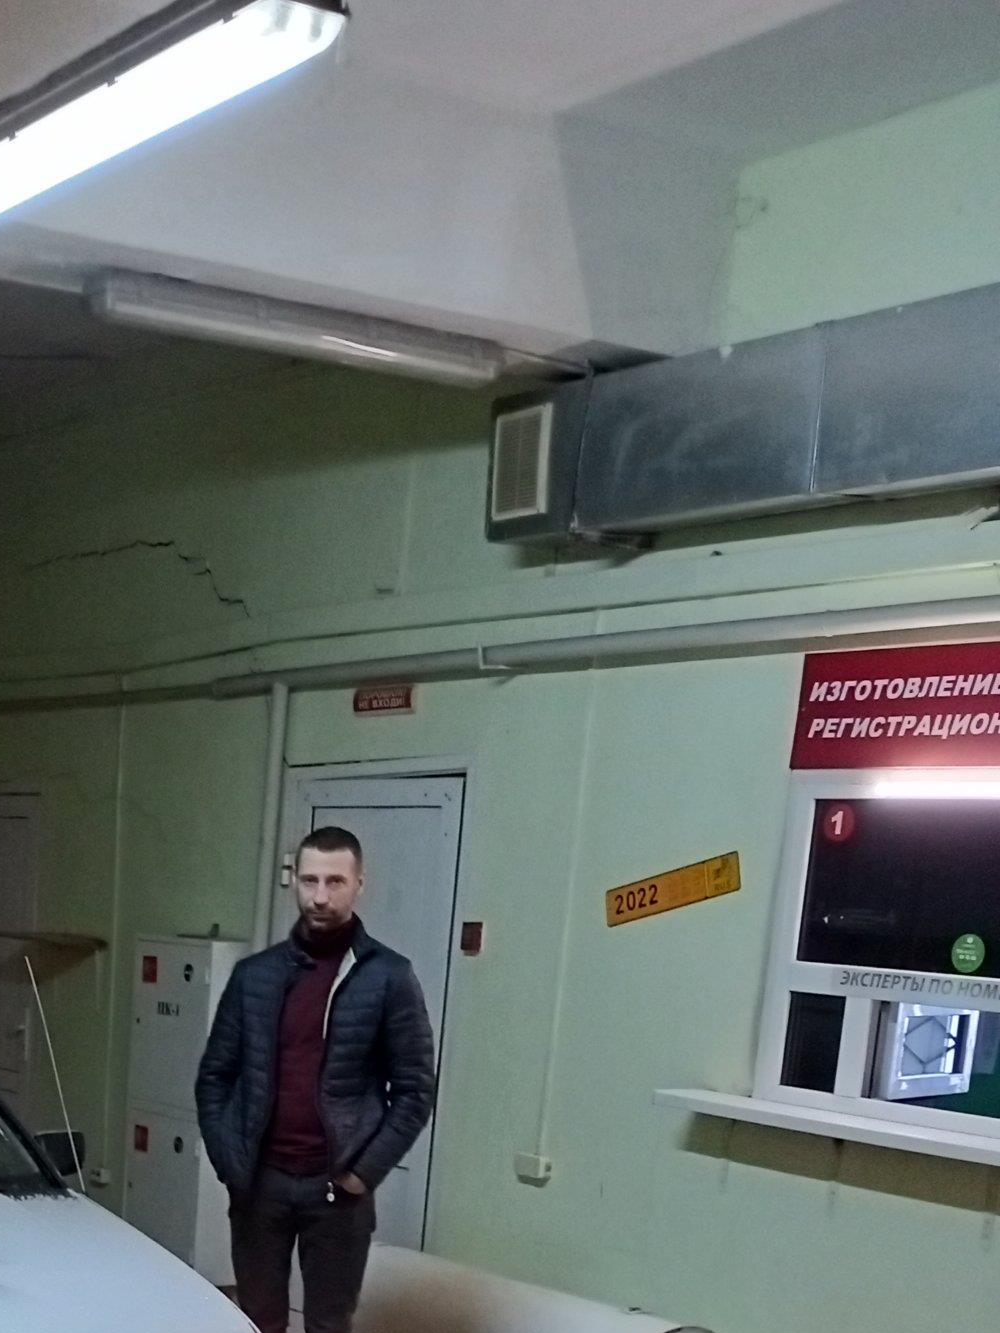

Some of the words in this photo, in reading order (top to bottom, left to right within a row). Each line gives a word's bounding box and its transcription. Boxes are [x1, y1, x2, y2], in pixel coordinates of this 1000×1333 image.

[808, 713, 1000, 739] РЕГИСТРАЦИОН
[831, 811, 844, 835] 1
[615, 884, 658, 915] 2022
[840, 970, 925, 992] ЭКСПЕРТЫ
[930, 978, 953, 995] ПО
[957, 981, 1000, 1000] НОМ
